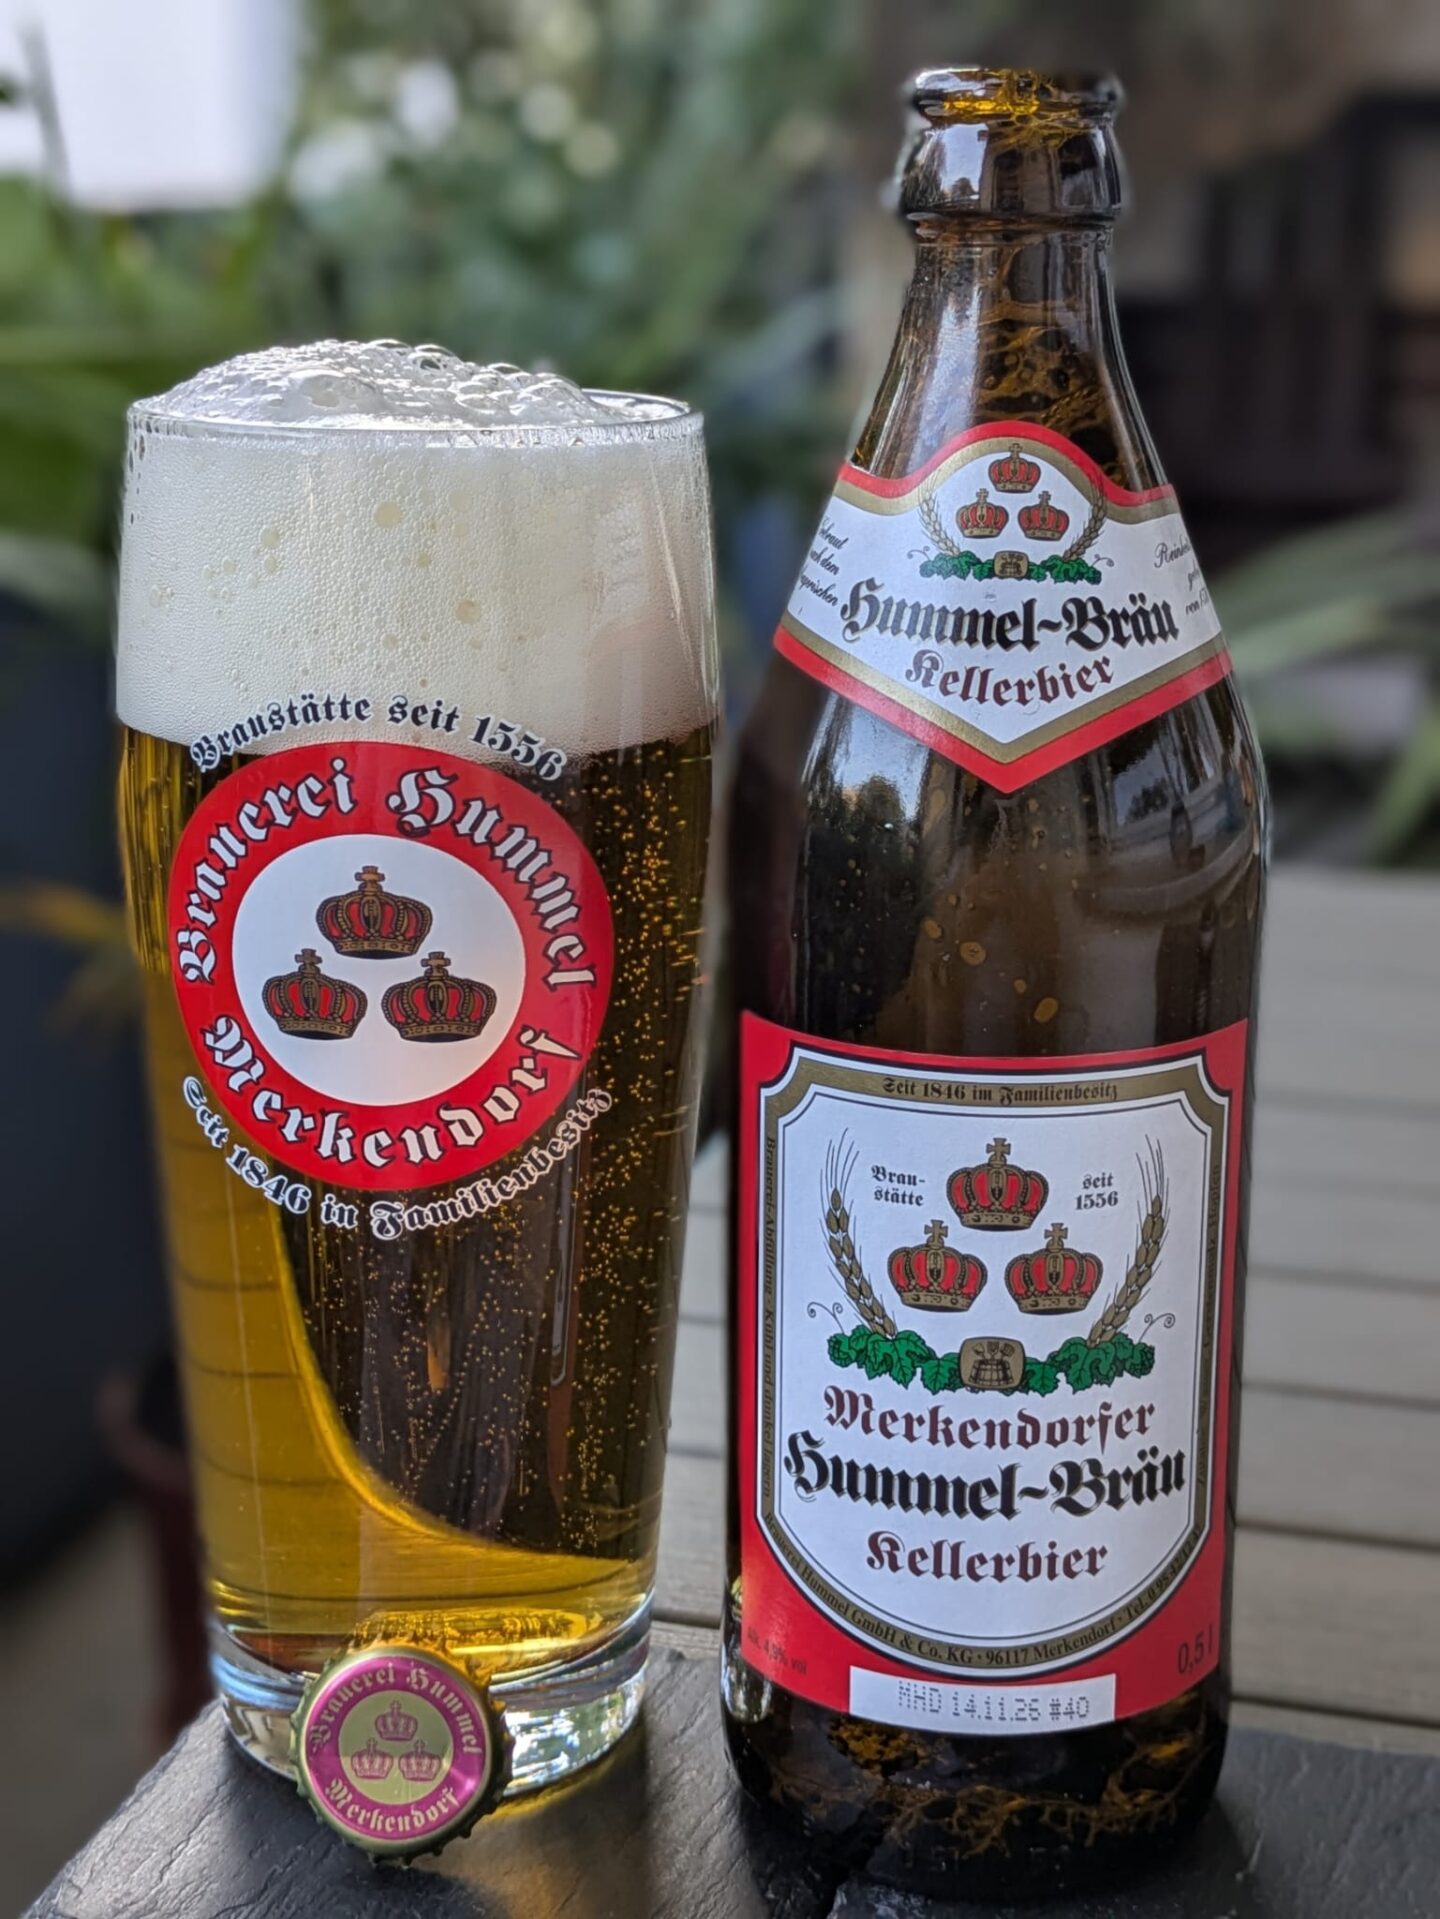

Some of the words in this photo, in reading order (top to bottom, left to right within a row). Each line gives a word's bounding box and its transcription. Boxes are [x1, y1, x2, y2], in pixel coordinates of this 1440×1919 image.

[840, 576, 1179, 651] Hummel-Bräu
[905, 649, 1114, 707] Kellerbier
[190, 693, 372, 774] Braustätte
[387, 695, 461, 733] seit
[470, 714, 569, 782] 1556
[176, 757, 356, 984] Brauerei
[386, 766, 597, 992] Hummel
[202, 1014, 582, 1169] Merkendorf
[882, 1076, 916, 1095] Seit
[923, 1081, 965, 1100] 1846
[972, 1087, 992, 1100] im
[1000, 1082, 1118, 1106] Familienbesitz
[182, 1075, 231, 1149] Seit
[225, 1144, 312, 1215] 1846
[320, 1194, 358, 1230] in
[369, 1088, 614, 1241] Familienbesitz
[871, 1165, 926, 1186] Brau-
[1082, 1172, 1114, 1190] seit
[874, 1186, 924, 1207] stätte
[1075, 1191, 1119, 1210] 1556
[824, 1385, 1156, 1455] Merkendorfer
[784, 1429, 1187, 1521] Hummel-Bräu
[867, 1531, 1108, 1583] Kellerbier
[801, 1568, 849, 1616] Hummel
[851, 1608, 897, 1644] GmbH
[899, 1634, 913, 1650] &
[917, 1639, 942, 1659] Co.
[947, 1648, 973, 1664] KG
[986, 1649, 1029, 1666] 96117
[1033, 1618, 1117, 1661] Merkendorf
[1178, 1631, 1205, 1675] 0,5
[309, 1661, 395, 1753] Brauerei
[405, 1665, 482, 1755] Hummel
[952, 1691, 1042, 1722] 14.11.26
[325, 1777, 461, 1834] Merkendorf
